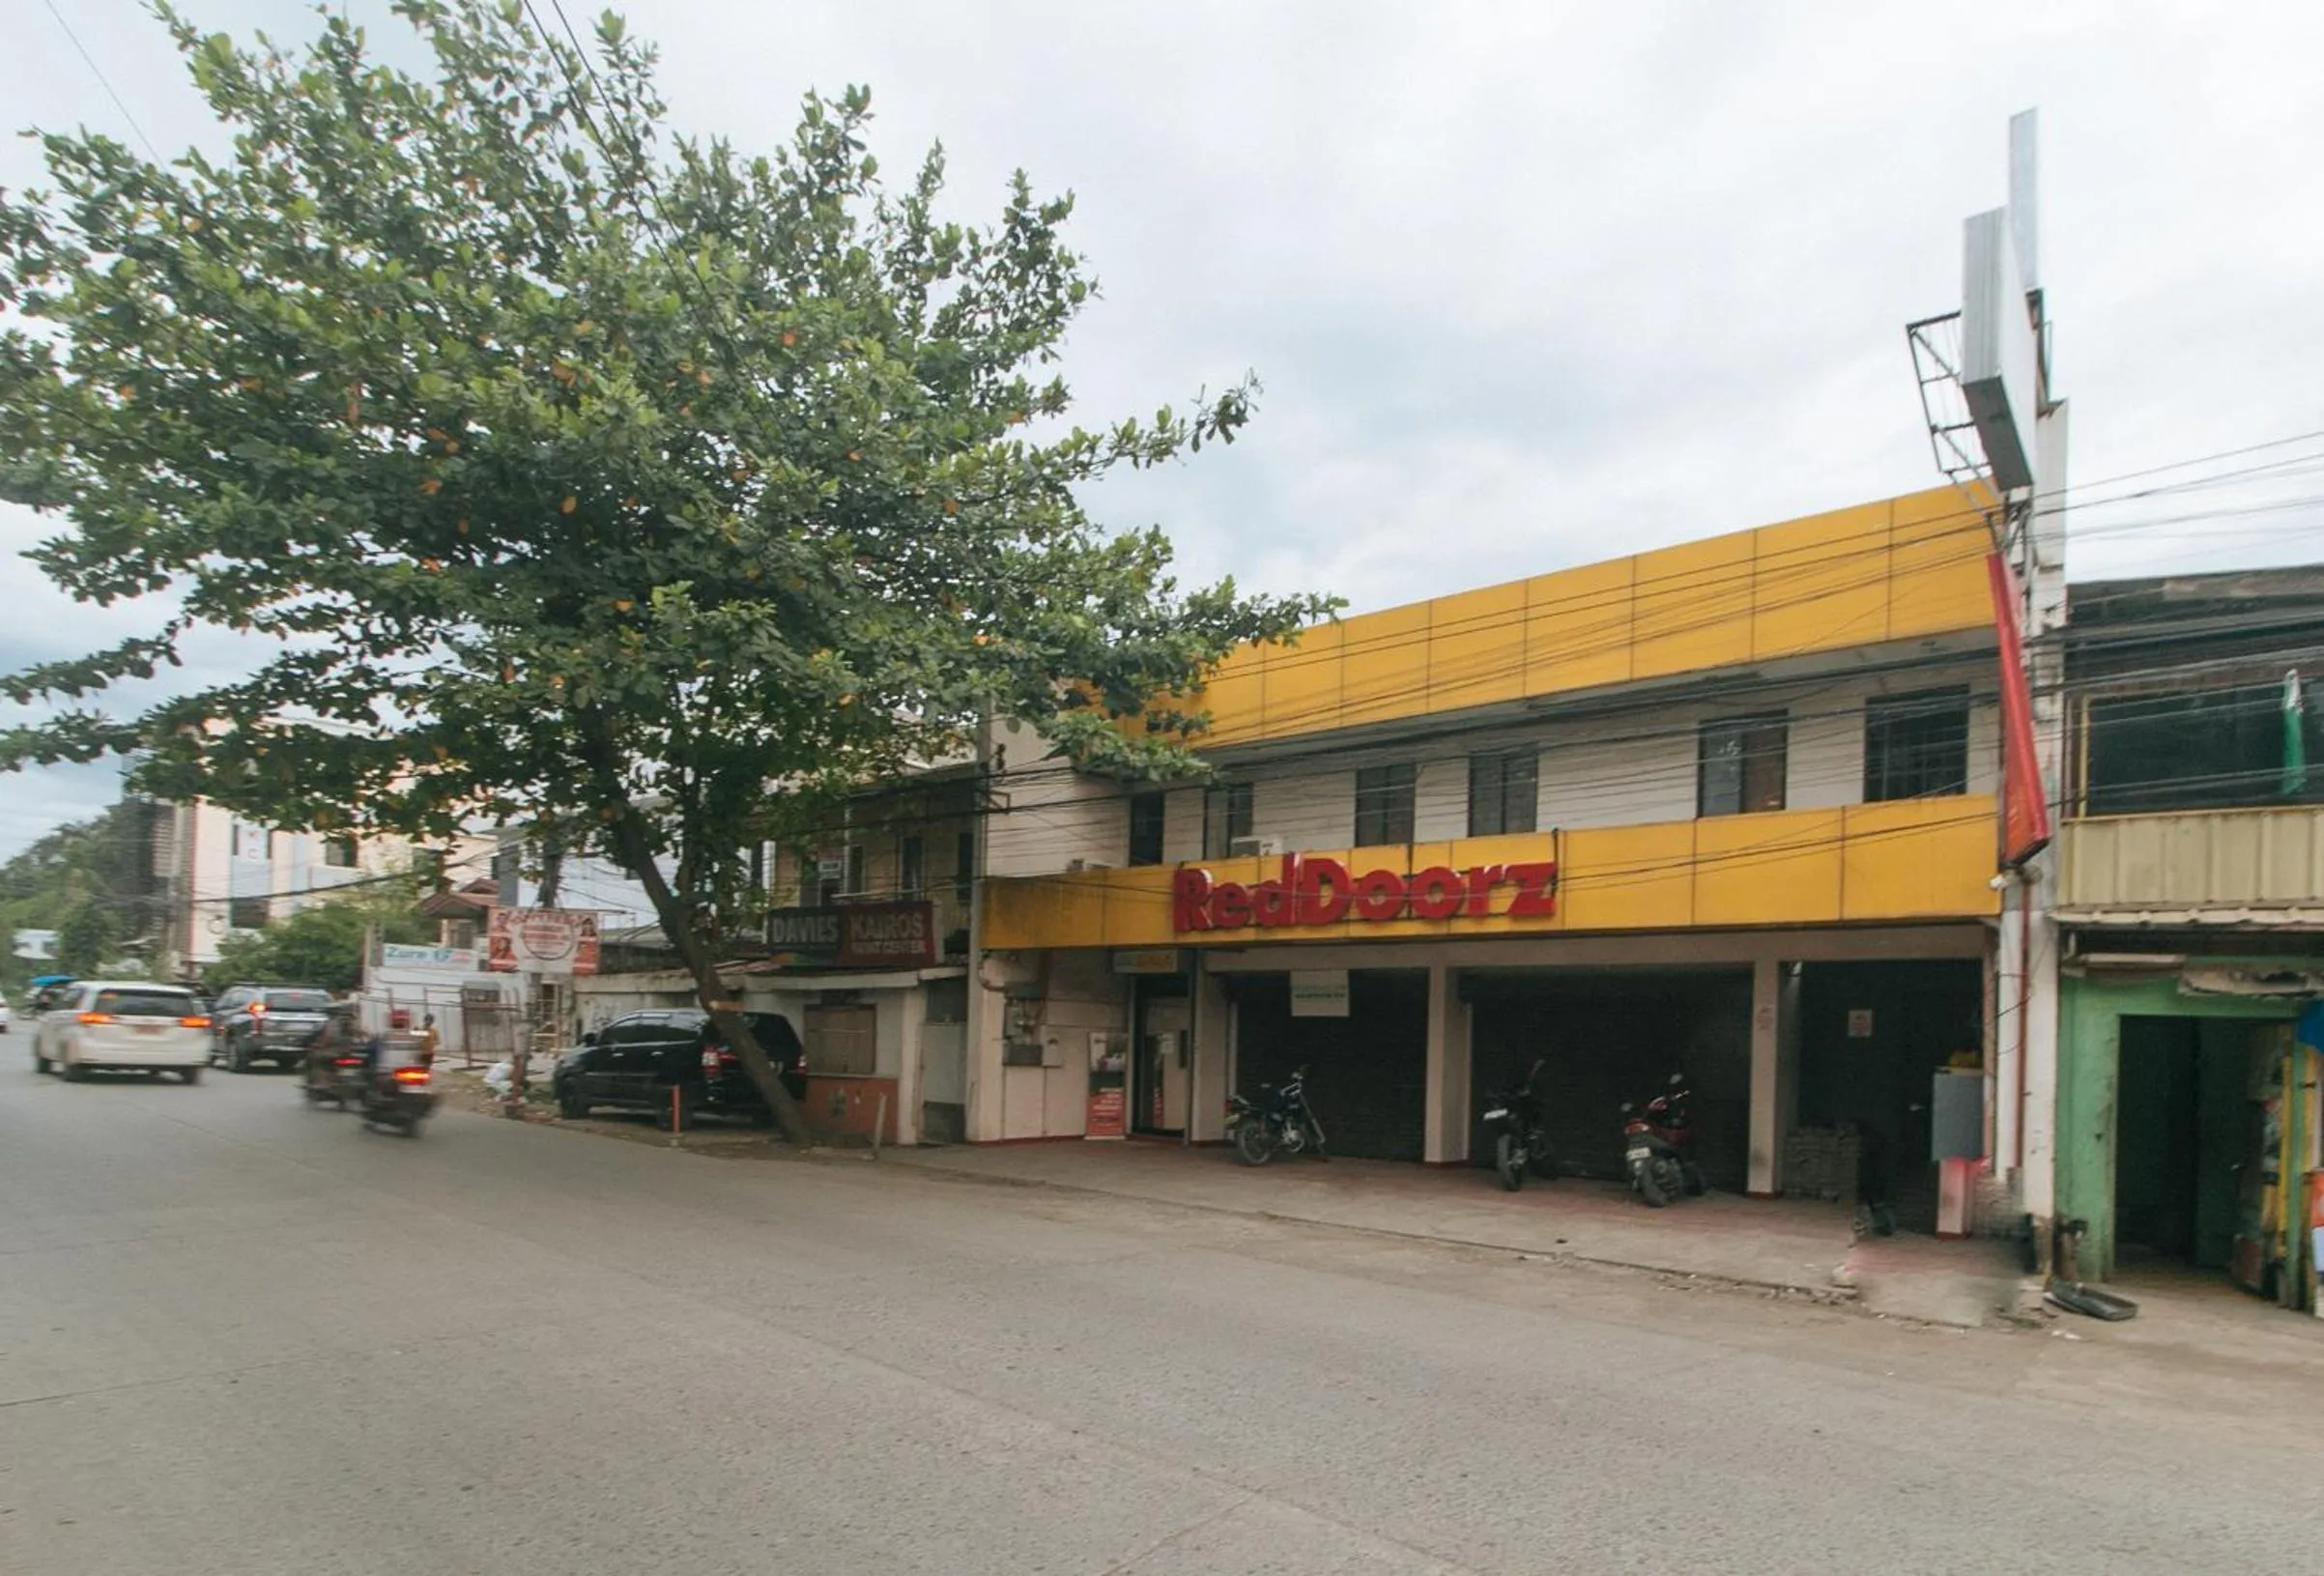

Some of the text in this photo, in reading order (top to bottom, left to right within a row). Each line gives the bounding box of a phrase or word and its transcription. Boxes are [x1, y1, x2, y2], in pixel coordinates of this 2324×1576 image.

[1173, 852, 1559, 933] RedDoorz
[772, 915, 839, 943] DAVIES
[848, 911, 924, 940] KAIROS
